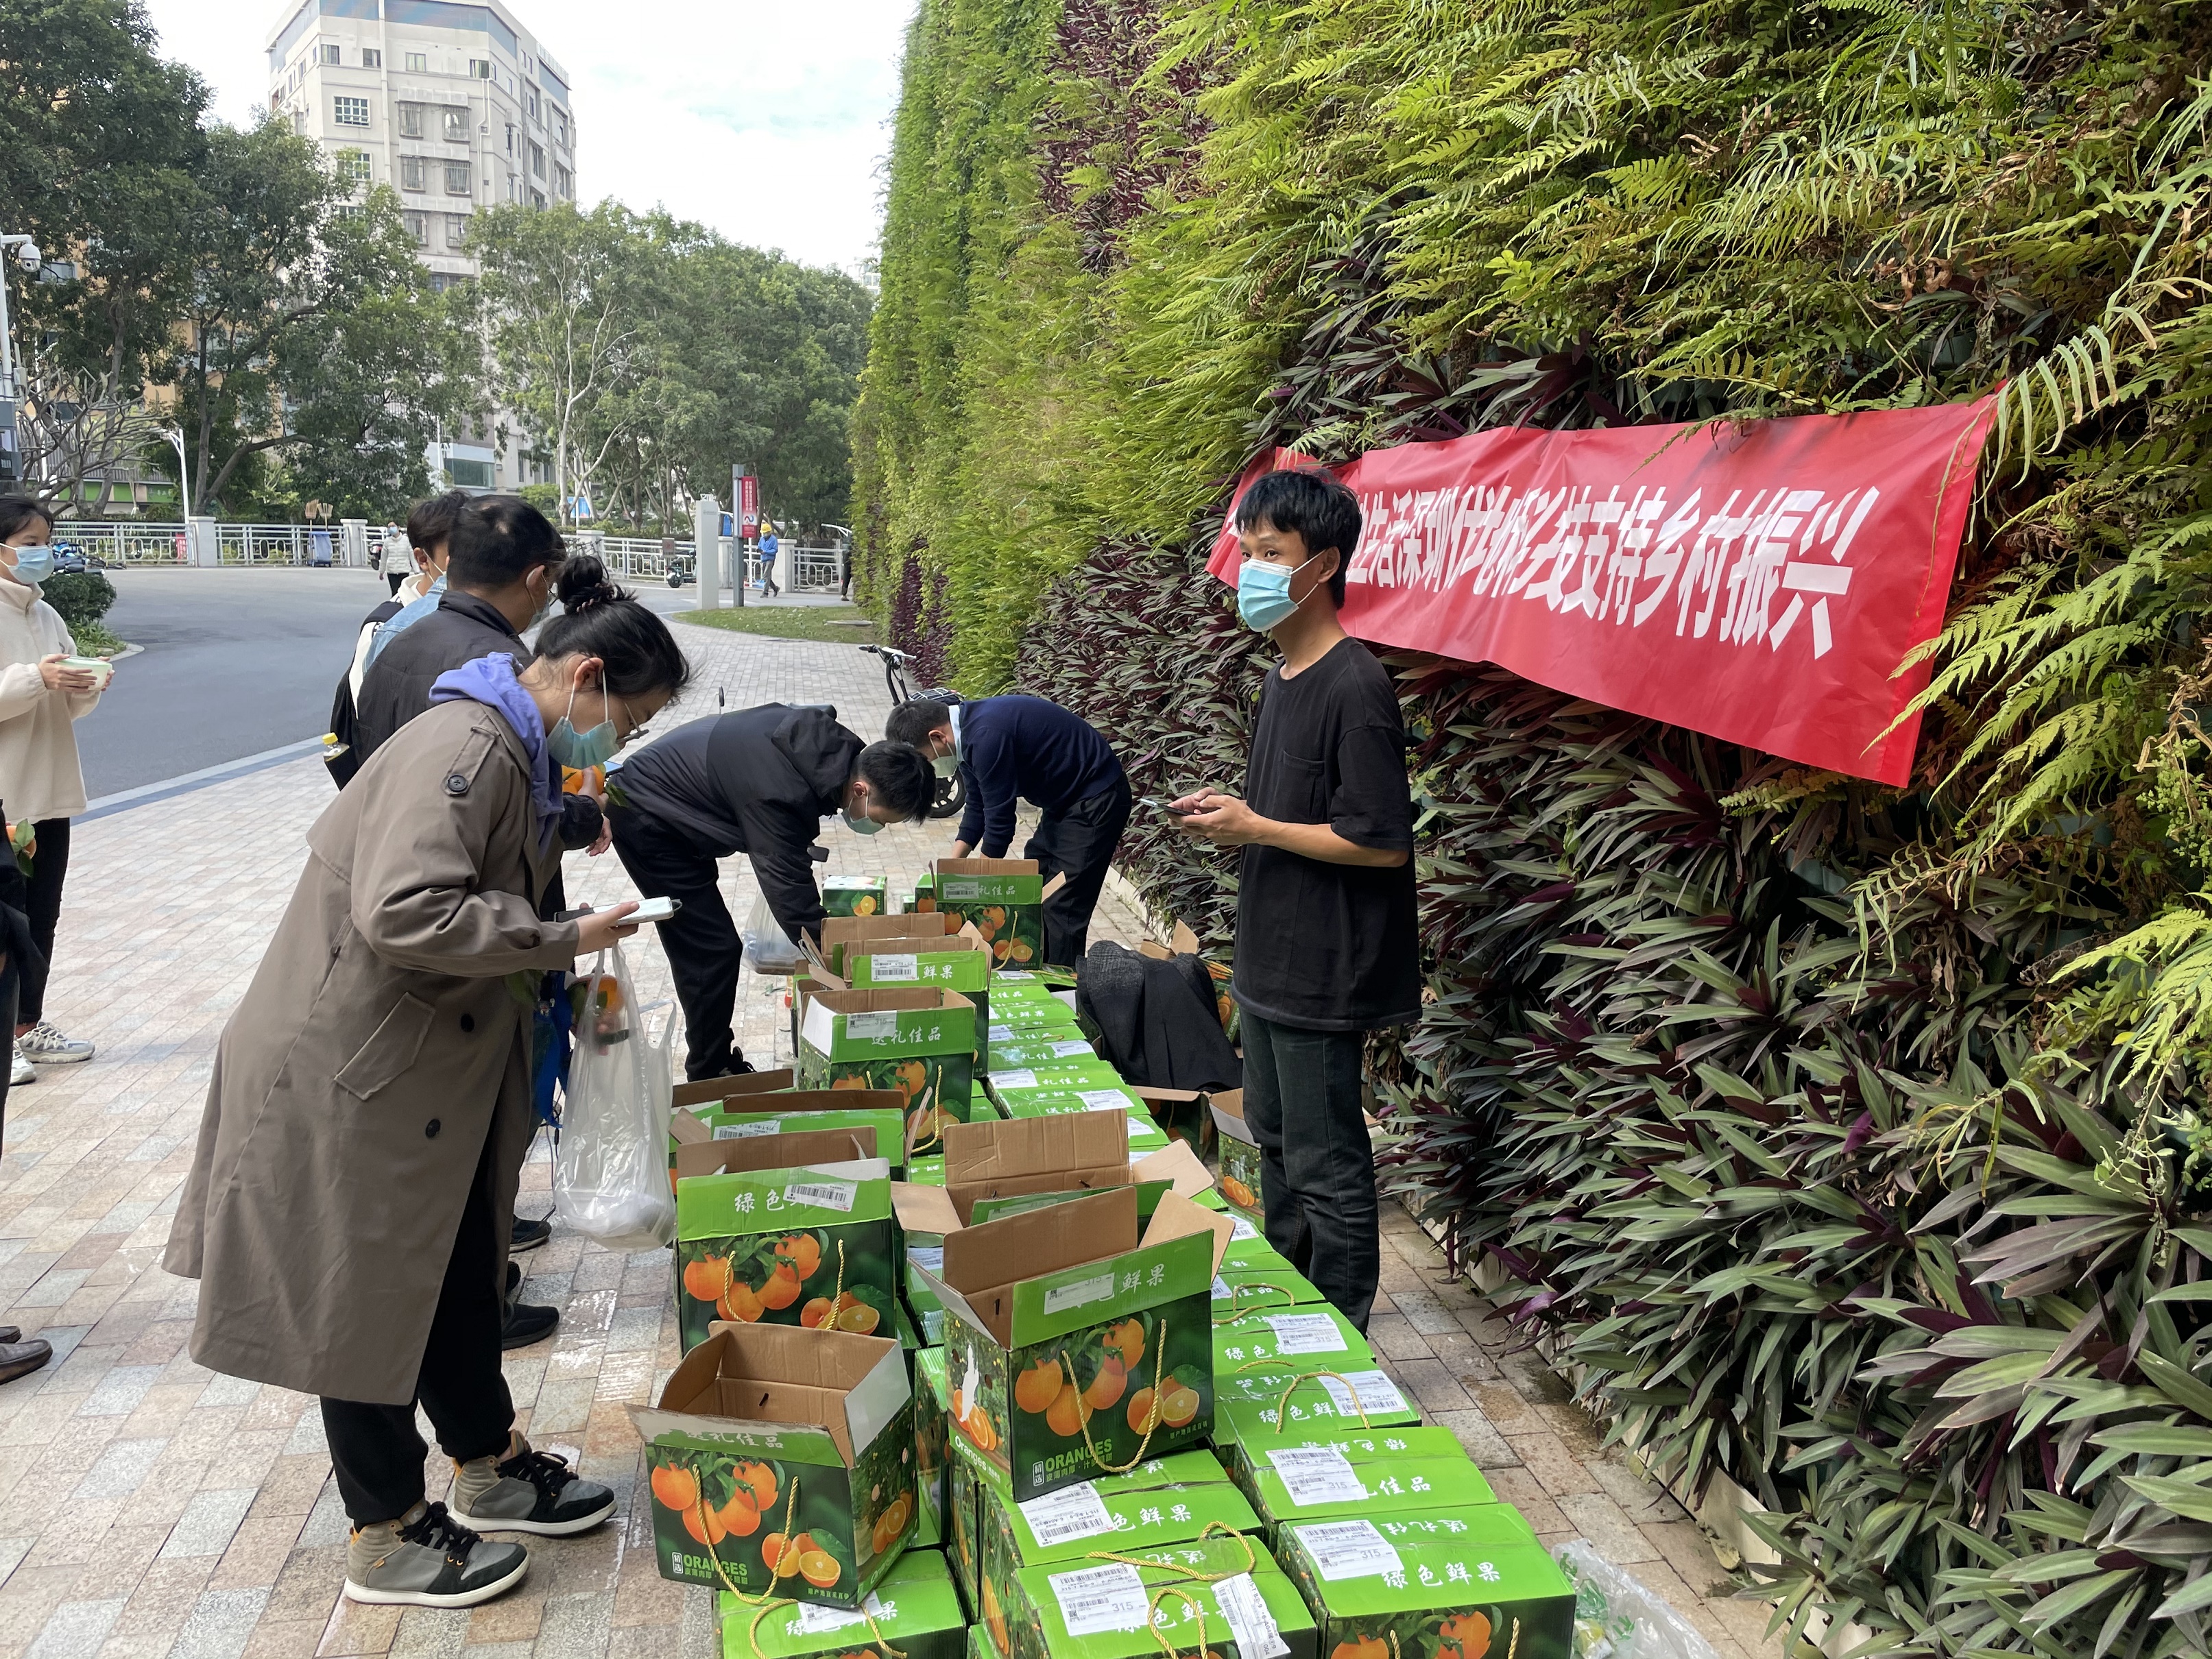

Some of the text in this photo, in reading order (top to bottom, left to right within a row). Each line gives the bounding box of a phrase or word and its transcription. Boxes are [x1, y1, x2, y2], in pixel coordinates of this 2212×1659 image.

[917, 965, 953, 981] 鲜果
[996, 1010, 1045, 1019] 色鲜果
[734, 1189, 807, 1213] 绿色
[1259, 1402, 1336, 1423] 绿色鲜
[954, 1435, 987, 1471] Oranges
[1045, 1438, 1112, 1473] ORANGES
[1362, 1476, 1431, 1496] 佳品
[1113, 1503, 1192, 1532] 色鲜果
[683, 1554, 747, 1576] ORANGES
[1360, 1549, 1381, 1559] 315
[1381, 1562, 1500, 1589] 绿色鲜果
[1111, 1601, 1133, 1612] 315
[785, 1600, 898, 1636] 绿果
